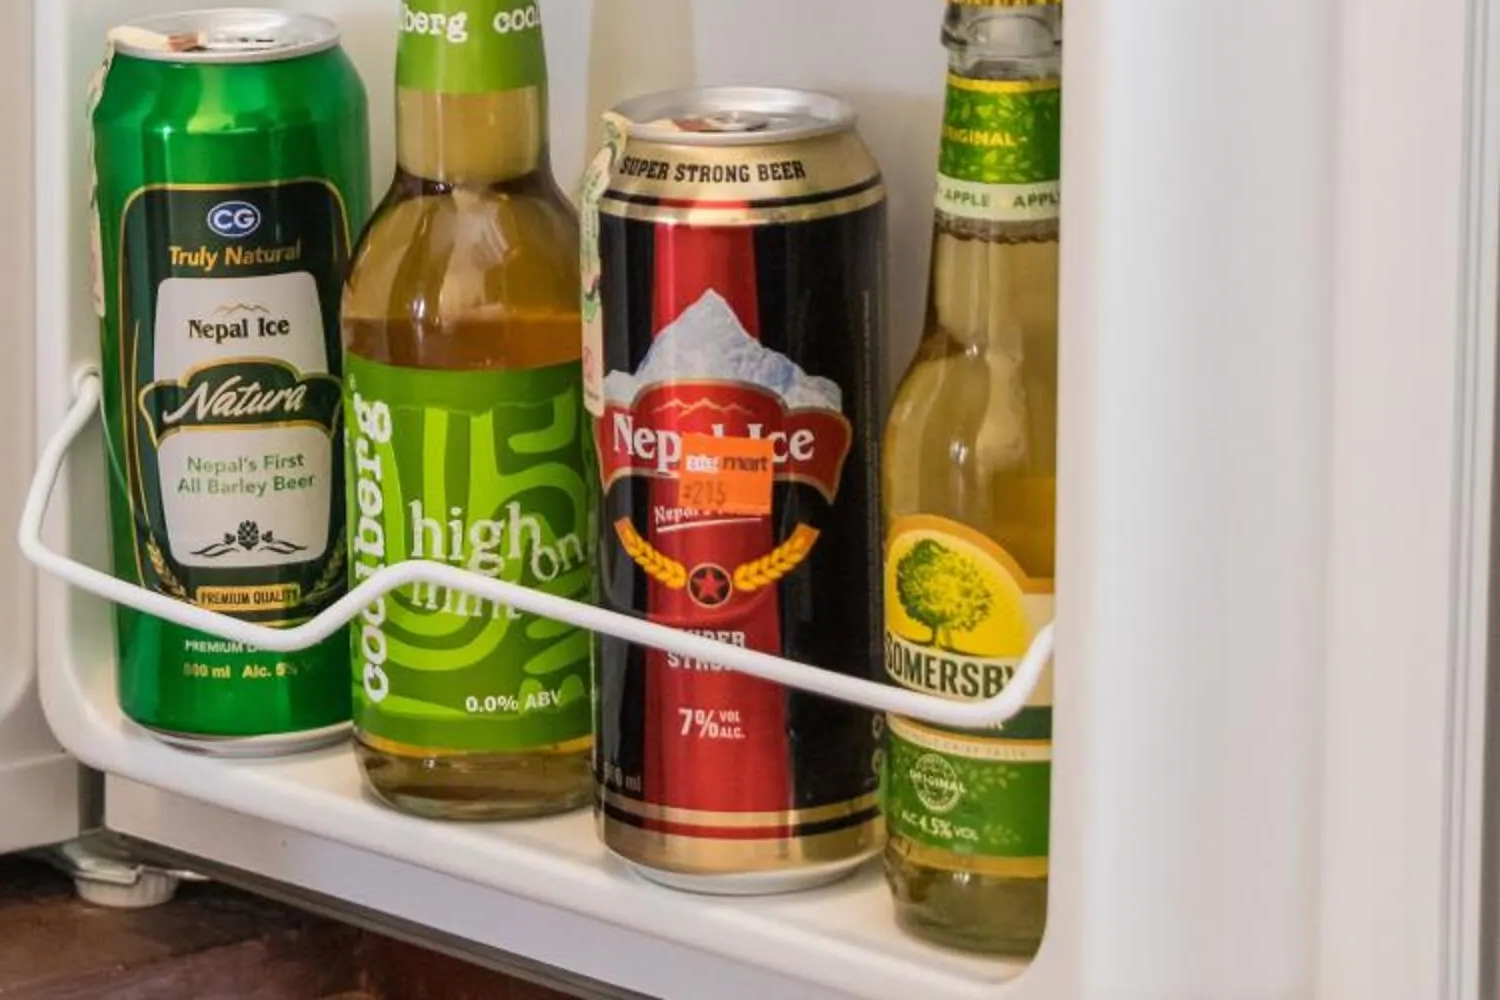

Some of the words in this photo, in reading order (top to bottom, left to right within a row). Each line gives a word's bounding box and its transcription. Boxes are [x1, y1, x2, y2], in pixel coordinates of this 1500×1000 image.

[619, 156, 669, 180] SUPER
[673, 162, 751, 183] STRONG
[757, 160, 807, 182] BEER
[1012, 190, 1060, 209] APPL
[211, 206, 256, 231] CG
[168, 245, 218, 271] Truly
[224, 243, 300, 266] Natural
[188, 319, 249, 344] Nepal
[258, 316, 290, 337] Ice
[612, 412, 726, 477] Nep
[186, 456, 257, 476] Nepal's
[263, 453, 306, 471] First
[177, 477, 201, 493] All
[206, 476, 267, 498] Barley
[273, 474, 316, 491] Beer
[409, 500, 541, 577] high
[530, 532, 586, 582] on
[200, 591, 250, 605] PREMIUM
[253, 588, 297, 605] QUALITY
[185, 639, 243, 653] PREMIUM
[212, 665, 232, 679] ml
[465, 694, 519, 713] 0.0%
[525, 688, 564, 711] ABV
[678, 707, 719, 739] 7%
